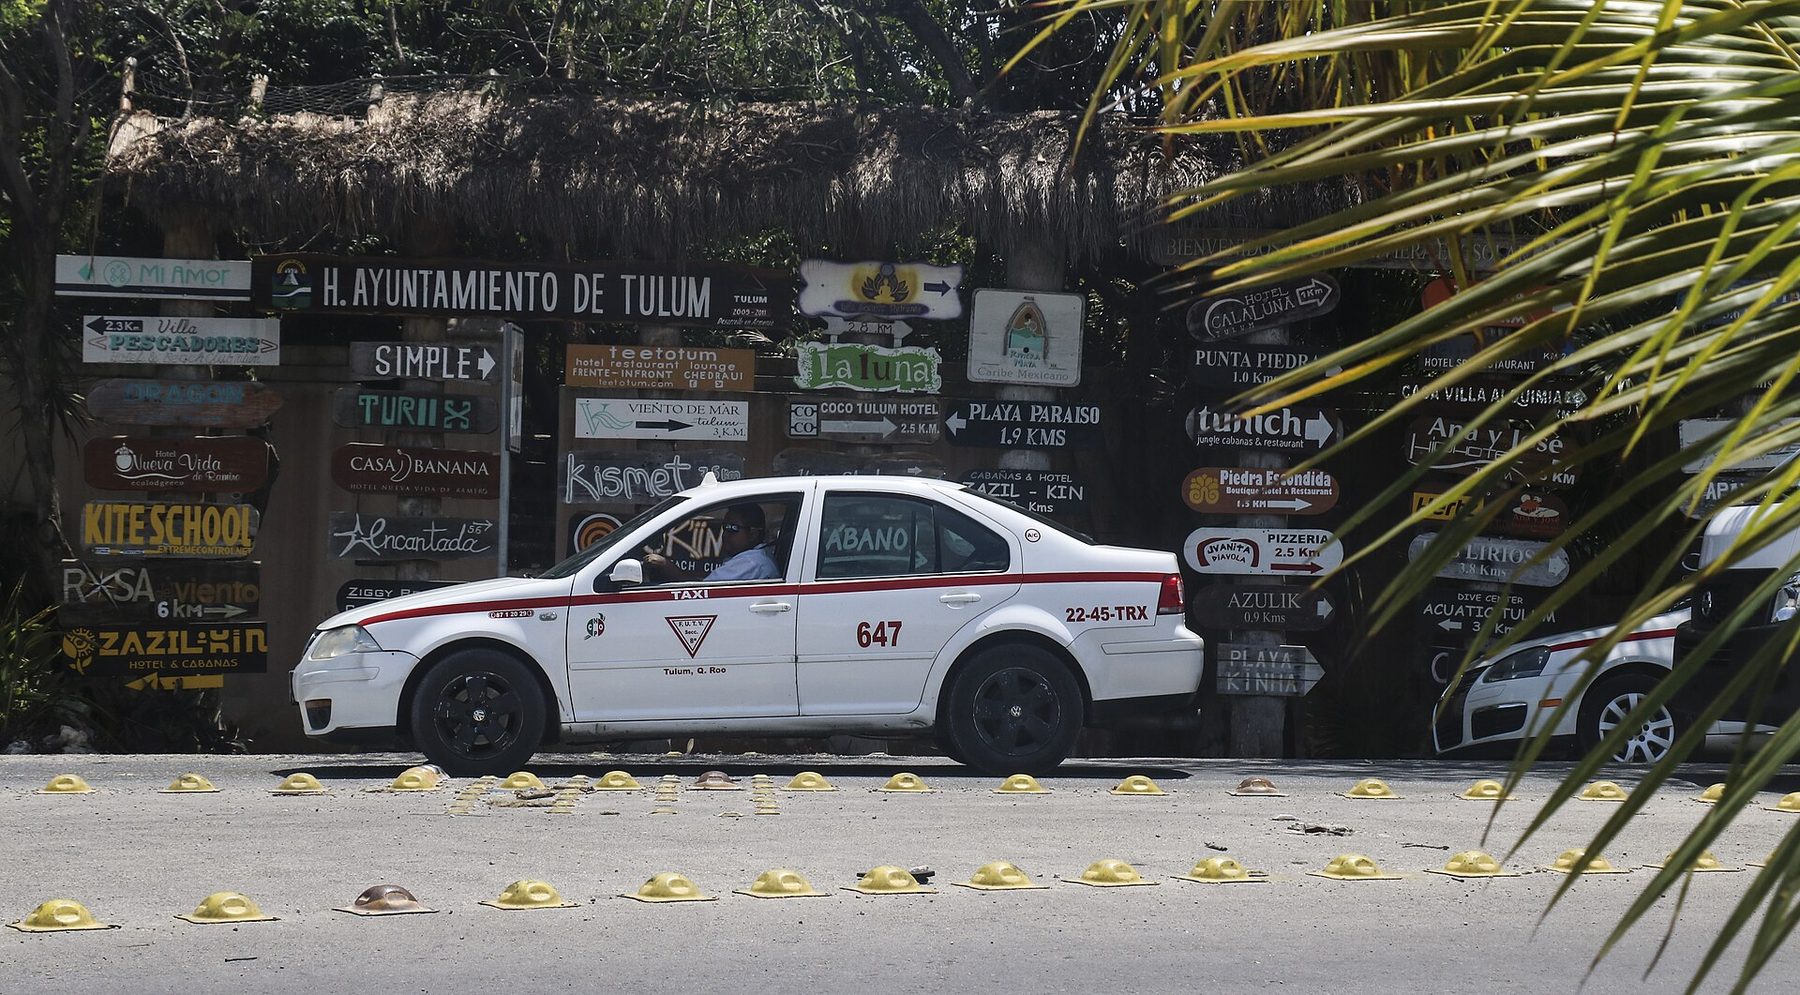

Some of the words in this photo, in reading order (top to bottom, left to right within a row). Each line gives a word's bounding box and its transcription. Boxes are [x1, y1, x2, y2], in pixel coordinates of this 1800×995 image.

[323, 267, 347, 307] H.
[352, 268, 558, 313] AYUNTAMIENTO
[574, 273, 605, 314] DE
[620, 274, 711, 318] TULUM
[733, 295, 768, 304] TULUM
[1244, 287, 1289, 305] HOTEL
[1211, 296, 1295, 328] CALALUNA
[158, 319, 198, 334] Villa
[109, 335, 260, 353] PESCADORES
[609, 346, 717, 361] teetotum
[1195, 350, 1251, 367] PUNTA
[375, 345, 471, 379] SIMPLE
[576, 358, 604, 367] hotel
[610, 360, 679, 369] restaurant
[690, 362, 736, 372] lounge
[1424, 358, 1453, 368] HOTEL
[684, 370, 743, 381] CHEDRAUI
[977, 367, 1013, 377] Caribe
[1018, 370, 1069, 380] Mexicano
[1233, 371, 1249, 383] 1.0
[599, 379, 673, 388] teetotum.com
[1401, 384, 1440, 400] CAA
[1445, 386, 1487, 402] VILLA
[629, 403, 683, 415] VIENTO
[687, 404, 706, 415] DE
[709, 405, 741, 416] MAR
[821, 403, 854, 415] COCO
[857, 403, 897, 415] TULUM
[900, 403, 938, 415] HOTEL
[968, 403, 1022, 422] PLAYA
[1029, 404, 1100, 424] PARAISO
[713, 428, 719, 437] 3
[900, 423, 917, 434] 2.5
[1428, 416, 1479, 441] Ana
[1000, 427, 1021, 445] 1.9
[1026, 428, 1066, 446] KMS
[1196, 434, 1221, 446] jungle
[1222, 435, 1253, 446] cabanas
[1255, 438, 1262, 446] &
[1264, 439, 1304, 448] restaurant
[155, 450, 176, 458] Hotel
[132, 453, 173, 471] Nueva
[178, 453, 221, 471] Vida
[350, 457, 395, 472] CASA
[414, 459, 489, 476] BANANA
[970, 470, 1021, 480] CABAÑAS
[1025, 473, 1032, 481] &
[1039, 473, 1073, 483] HOTEL
[1220, 470, 1263, 485] Piedra
[1047, 485, 1083, 500] KIN
[1291, 487, 1332, 496] Restaurant
[1029, 502, 1054, 512] Kms
[1252, 500, 1267, 508] KM
[85, 504, 145, 544] KITE
[149, 504, 252, 547] SCHOOL
[824, 523, 908, 551] ÁBANO
[1268, 534, 1328, 544] PIZZERIA
[1275, 548, 1294, 557] 2.5
[1466, 544, 1535, 564] LIRIOS
[1459, 563, 1476, 574] 3.8
[1480, 564, 1507, 576] Kms
[349, 587, 393, 598] ZIGGY
[671, 590, 708, 600] TAXI
[1458, 593, 1481, 601] DIVE
[1227, 592, 1301, 609] AZULIK
[157, 601, 169, 618] 6
[1065, 605, 1149, 623] 22-45-TRX
[1503, 607, 1556, 623] TULM
[1244, 612, 1259, 623] 0.9
[1263, 612, 1286, 623] Kms
[856, 620, 903, 648] 647
[129, 660, 165, 670] HOTEL
[170, 660, 179, 669] &
[182, 658, 239, 669] CABANAS
[1230, 651, 1292, 669] PLAYA
[664, 668, 694, 676] Tulum,
[709, 666, 727, 674] Roo
